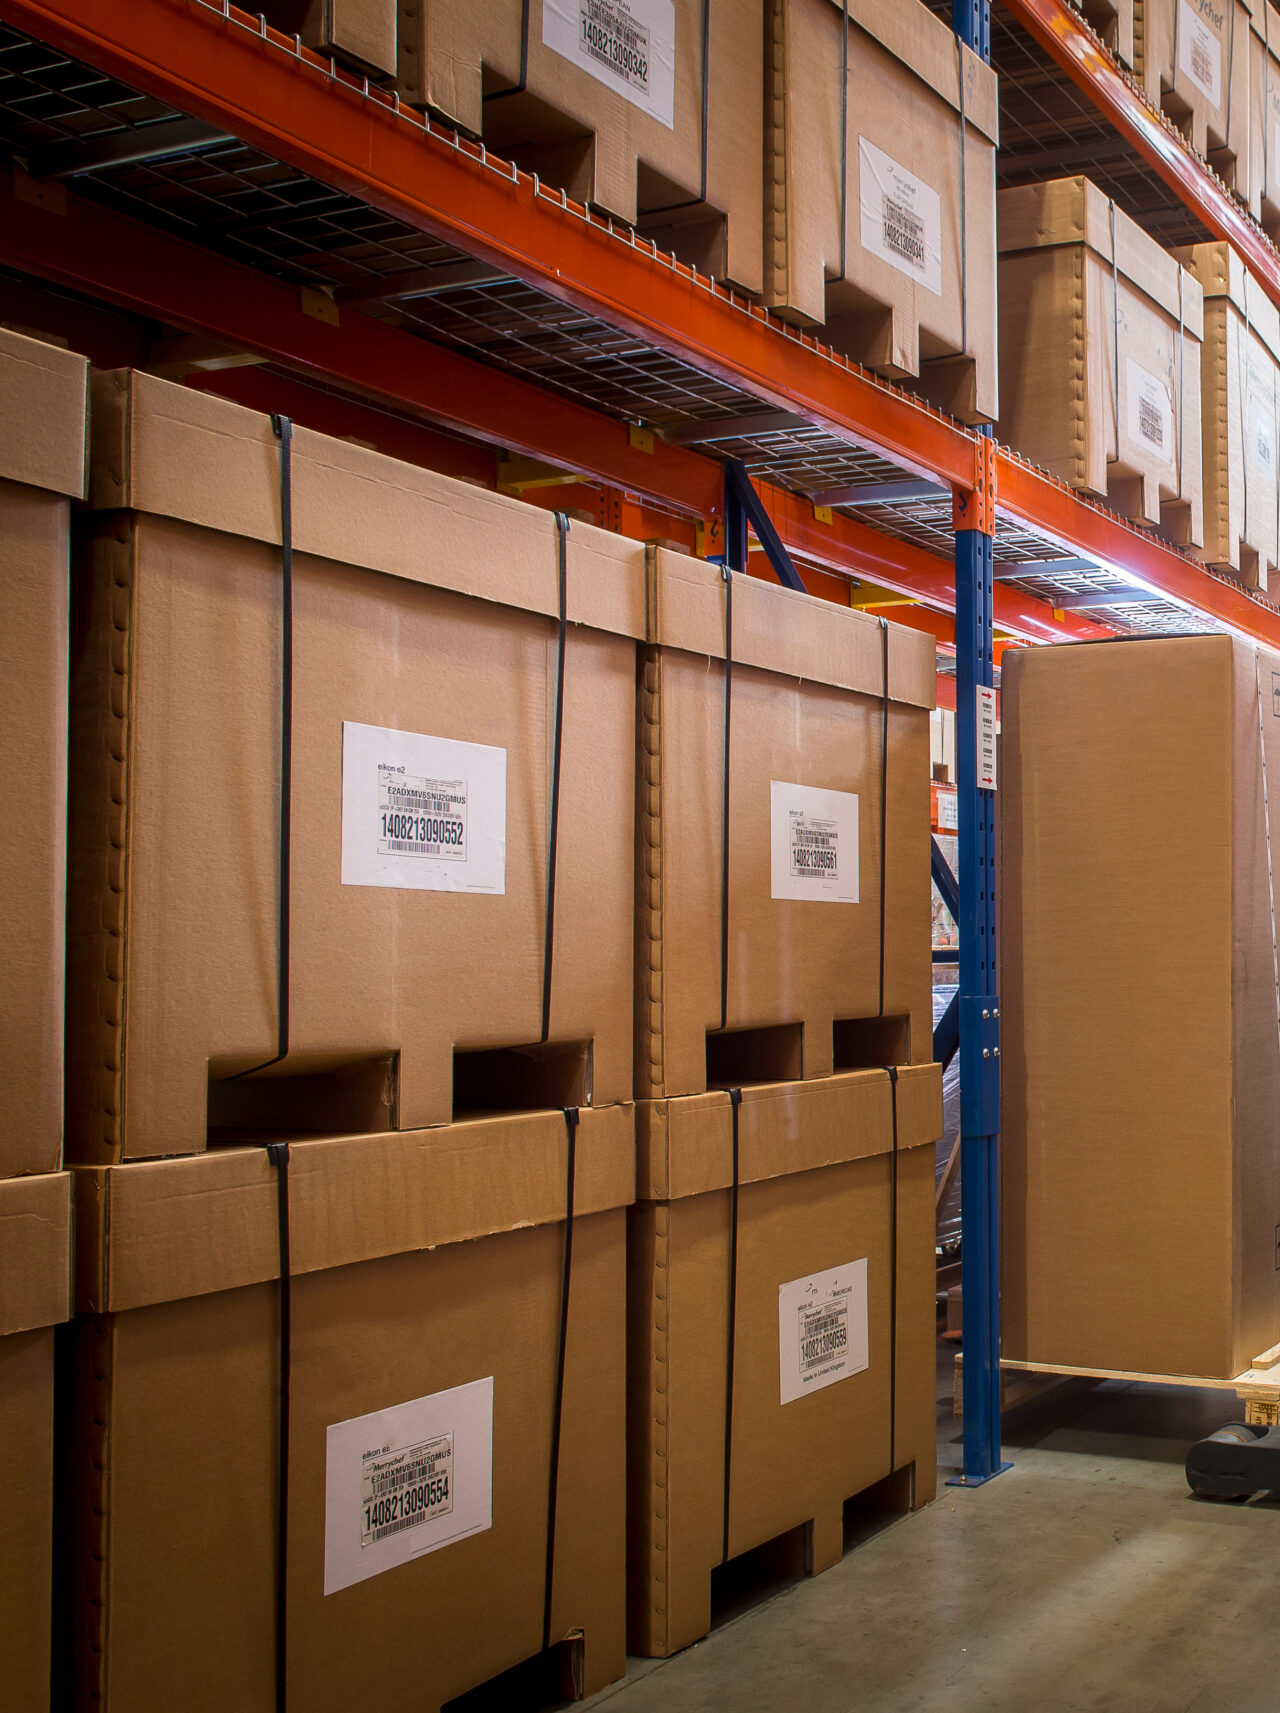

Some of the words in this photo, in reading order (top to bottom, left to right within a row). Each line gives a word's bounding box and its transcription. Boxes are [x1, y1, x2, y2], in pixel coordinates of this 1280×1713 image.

[1195, 0, 1223, 31] ychef
[582, 18, 648, 83] 1408213090342
[381, 813, 464, 846] 1408213090552
[373, 1454, 407, 1472] Merrychef
[365, 1475, 449, 1531] 1408213090554
